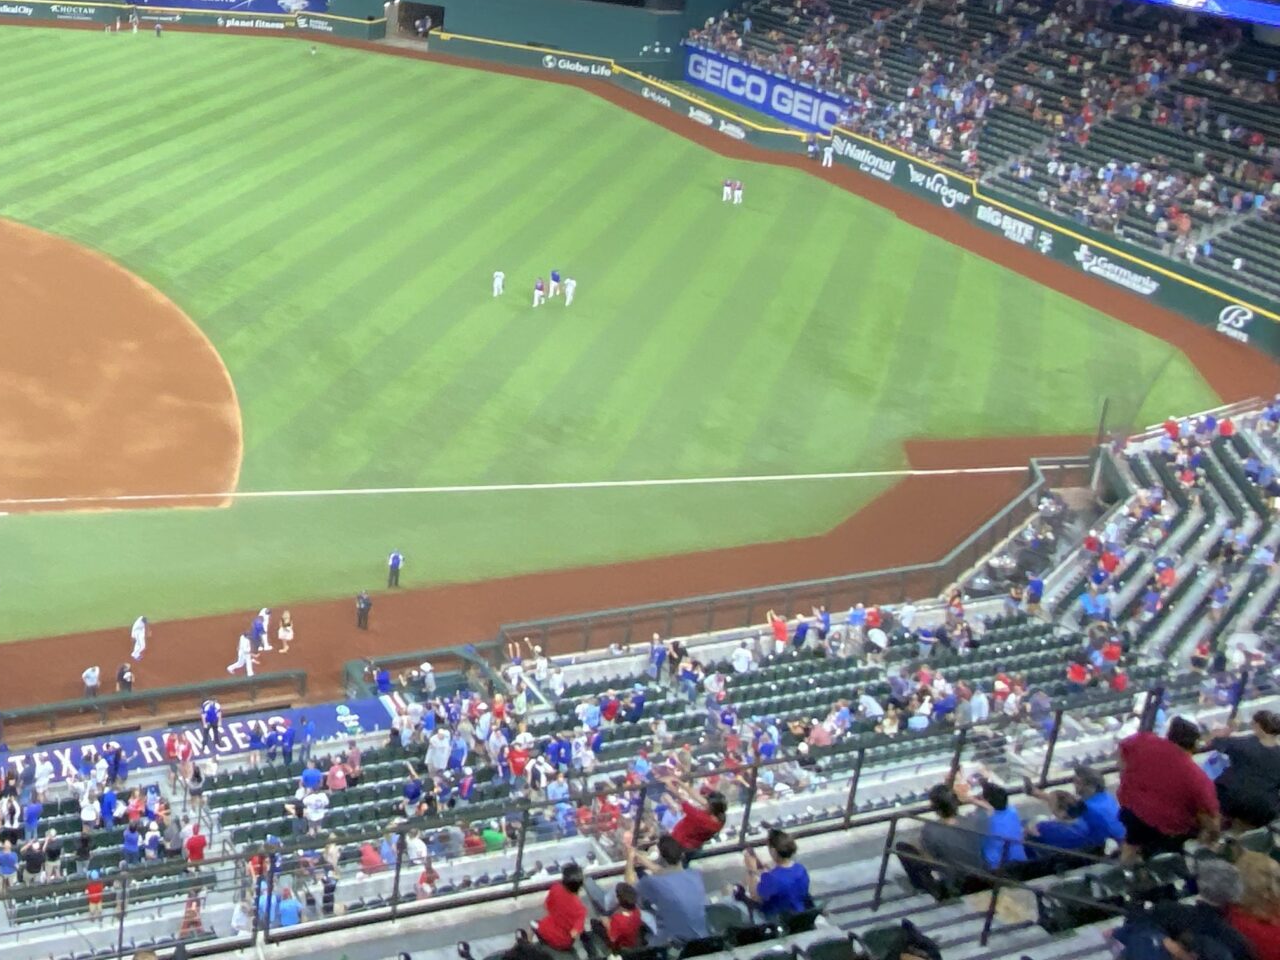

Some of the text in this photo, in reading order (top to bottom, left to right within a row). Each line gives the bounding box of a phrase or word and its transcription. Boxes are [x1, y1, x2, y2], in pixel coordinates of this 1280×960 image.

[18, 6, 33, 16] City
[55, 5, 96, 15] CHOCTAW
[226, 18, 285, 30] planet fitness
[558, 59, 611, 77] Globe Life
[688, 53, 841, 130] GEICO GEIC
[845, 142, 896, 174] National
[926, 173, 970, 208] Kroger
[1001, 215, 1034, 239] BITE
[1219, 305, 1253, 328] B
